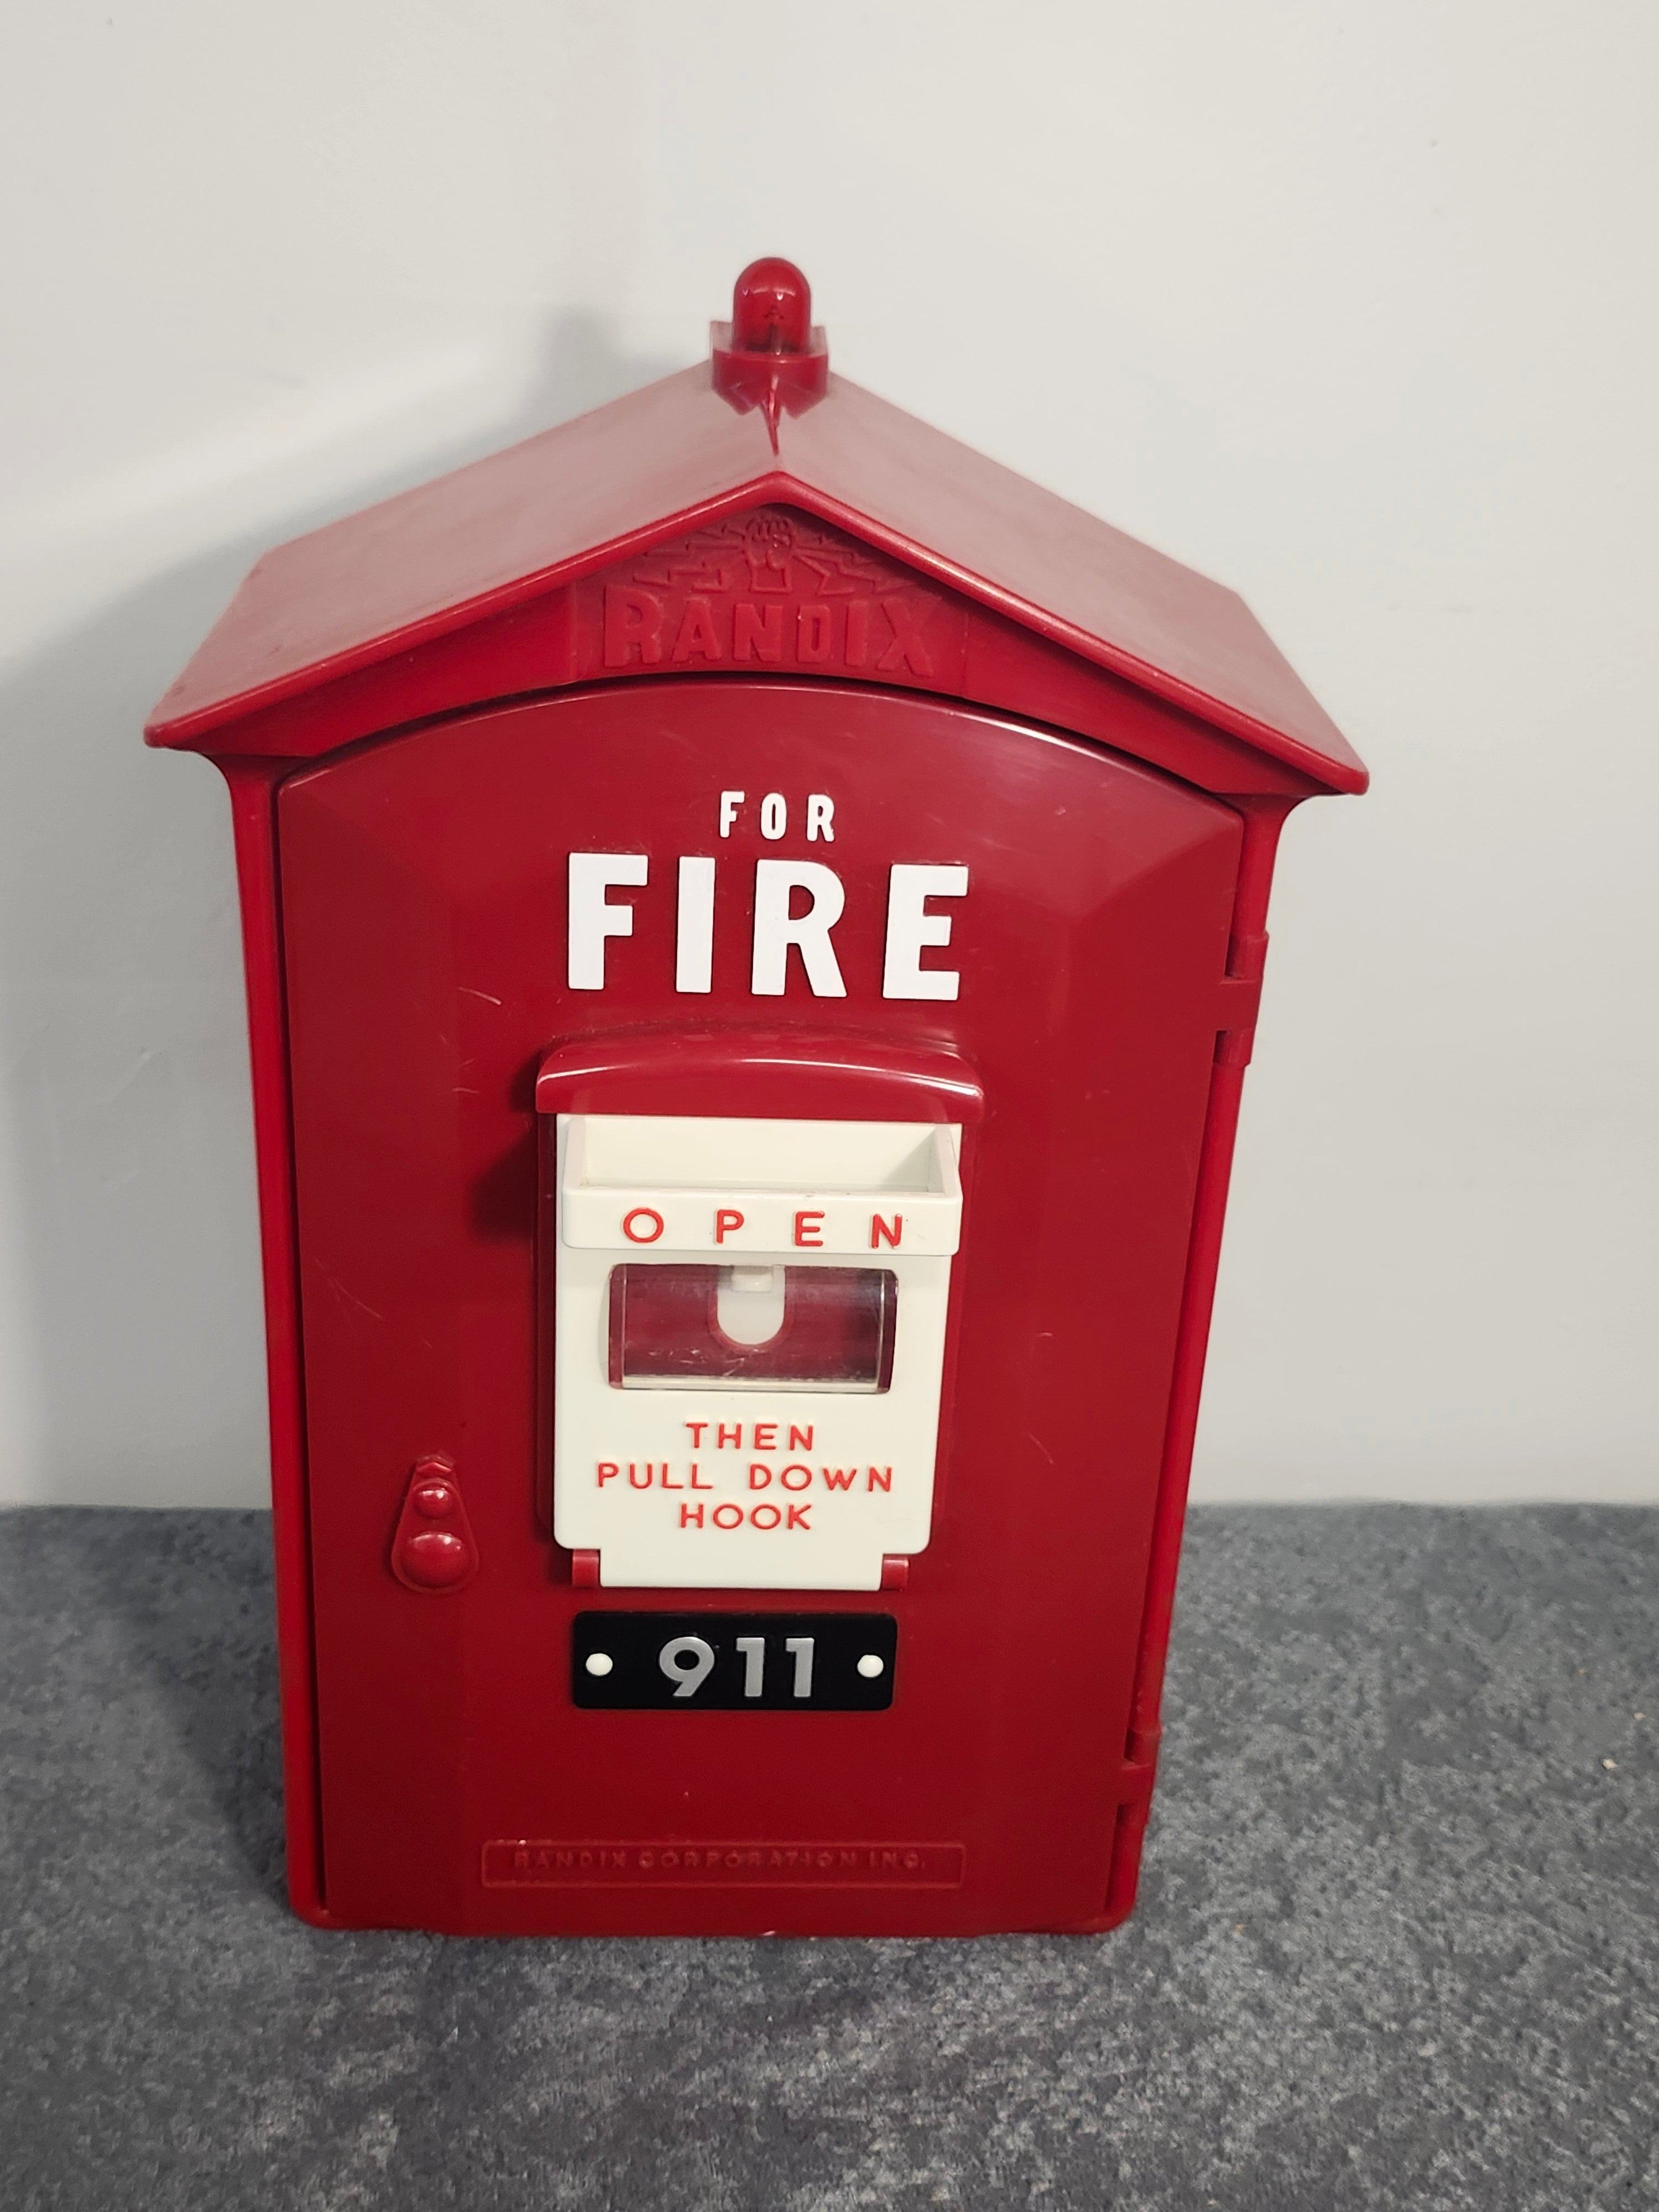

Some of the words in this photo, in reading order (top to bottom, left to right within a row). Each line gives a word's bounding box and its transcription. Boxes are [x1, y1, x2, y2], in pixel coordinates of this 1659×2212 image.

[604, 585, 934, 677] RANDIX
[720, 791, 834, 842] FOR
[568, 852, 969, 1001] FIRE
[622, 1207, 903, 1249] OPEN
[685, 1422, 814, 1451] THEN
[597, 1462, 713, 1490] PULL
[749, 1463, 893, 1493] DOWN
[679, 1503, 812, 1531] HOOK
[659, 1636, 815, 1698] 911
[514, 1849, 627, 1867] RANDIX
[638, 1849, 855, 1869] CORPORATION
